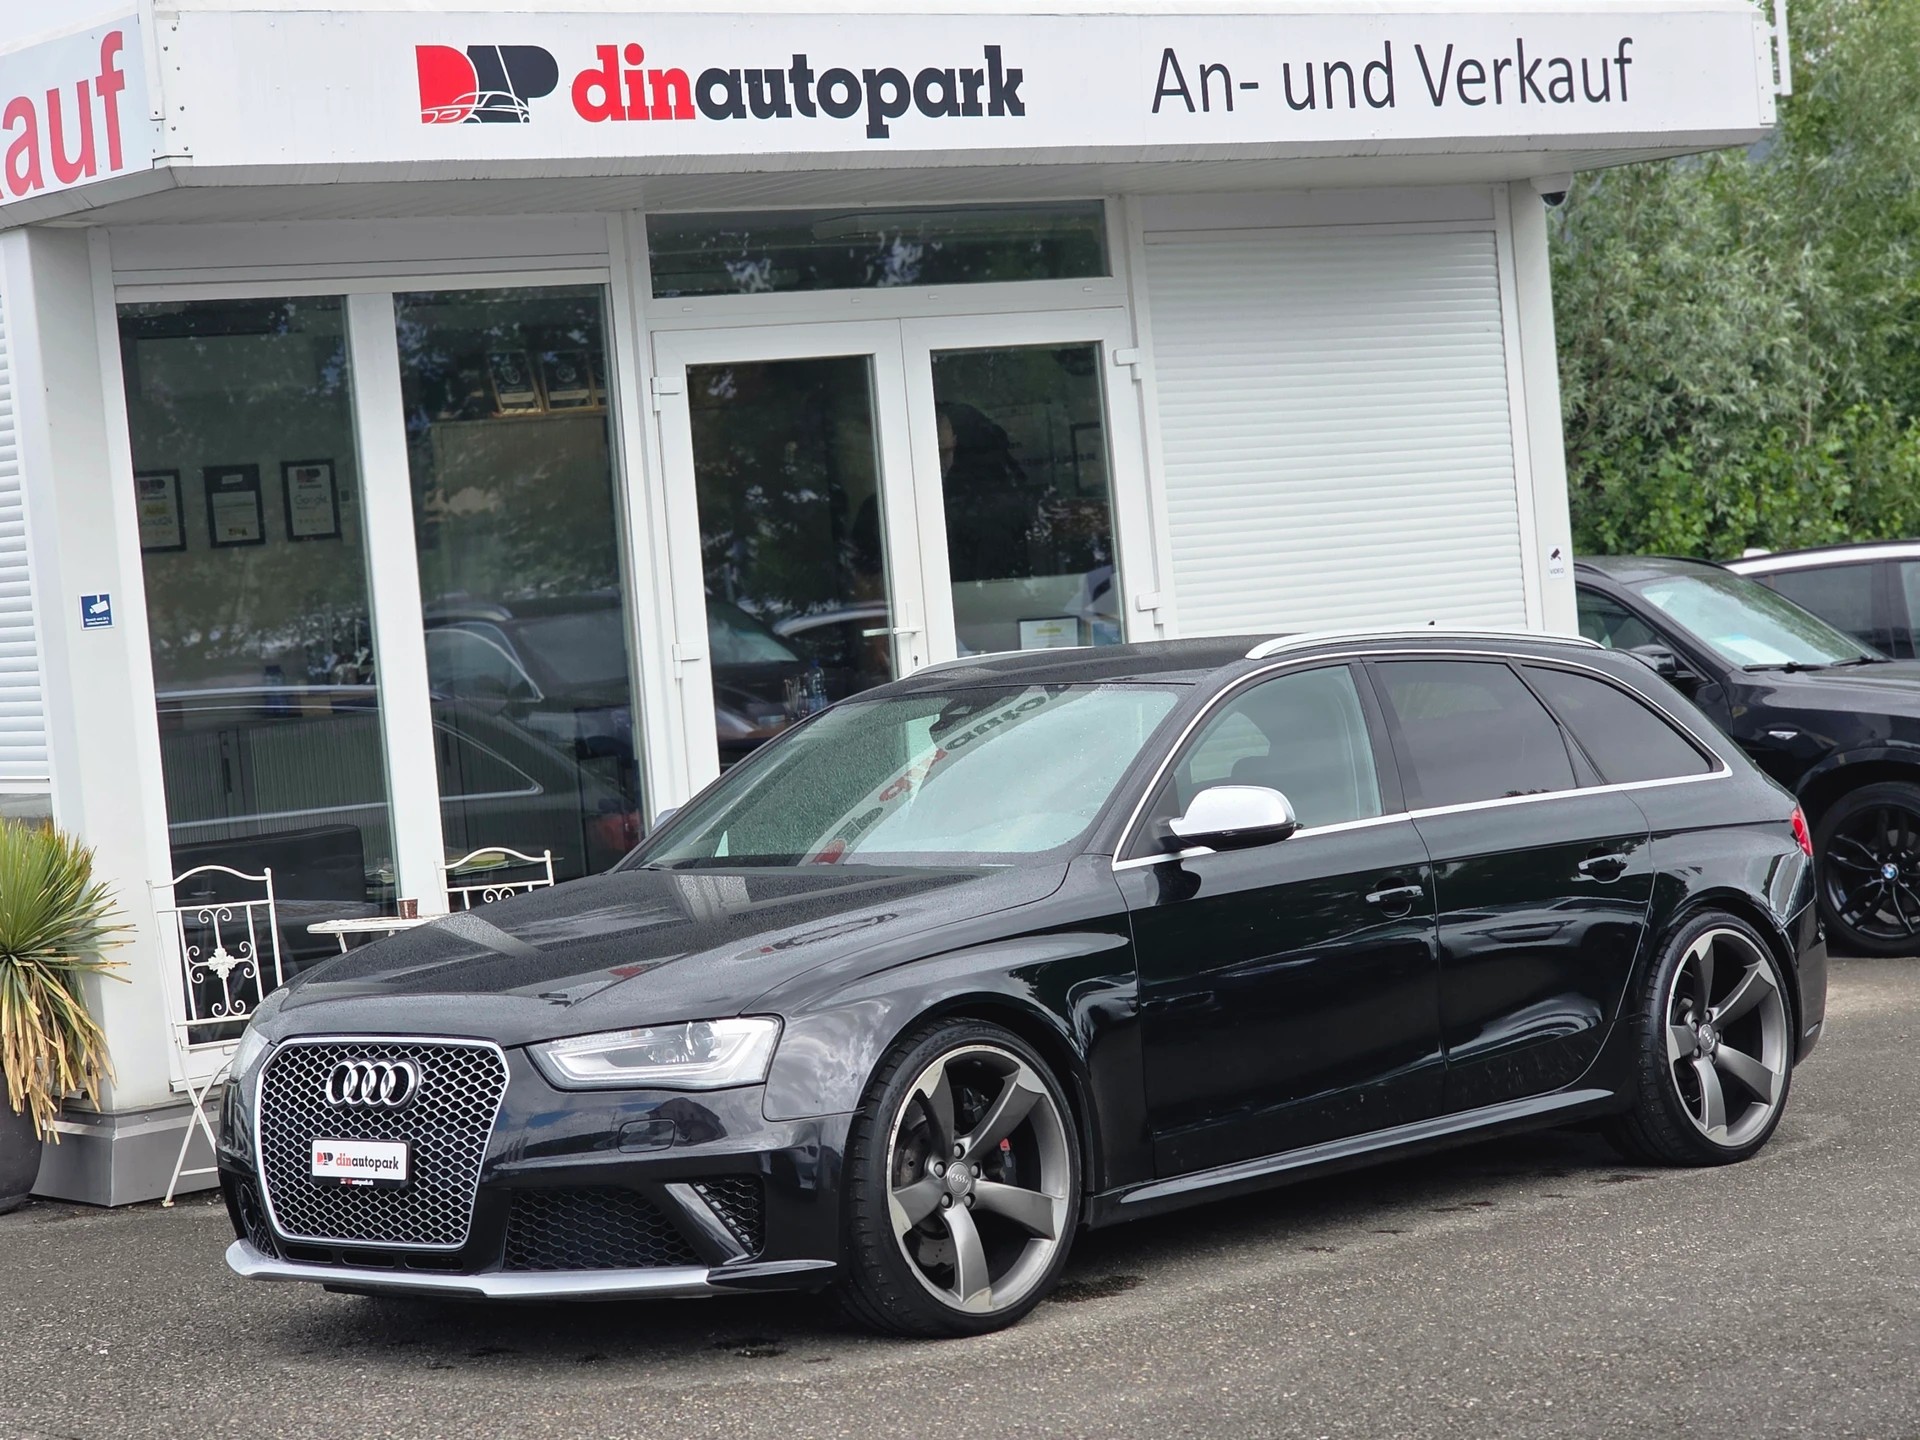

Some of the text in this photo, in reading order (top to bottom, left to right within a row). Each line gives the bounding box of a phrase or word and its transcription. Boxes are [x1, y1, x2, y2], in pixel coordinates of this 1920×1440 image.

[0, 31, 125, 199] auf
[571, 42, 1025, 140] dinautopark
[1151, 37, 1634, 114] An- und Verkauf
[336, 1153, 399, 1172] dinautopark
